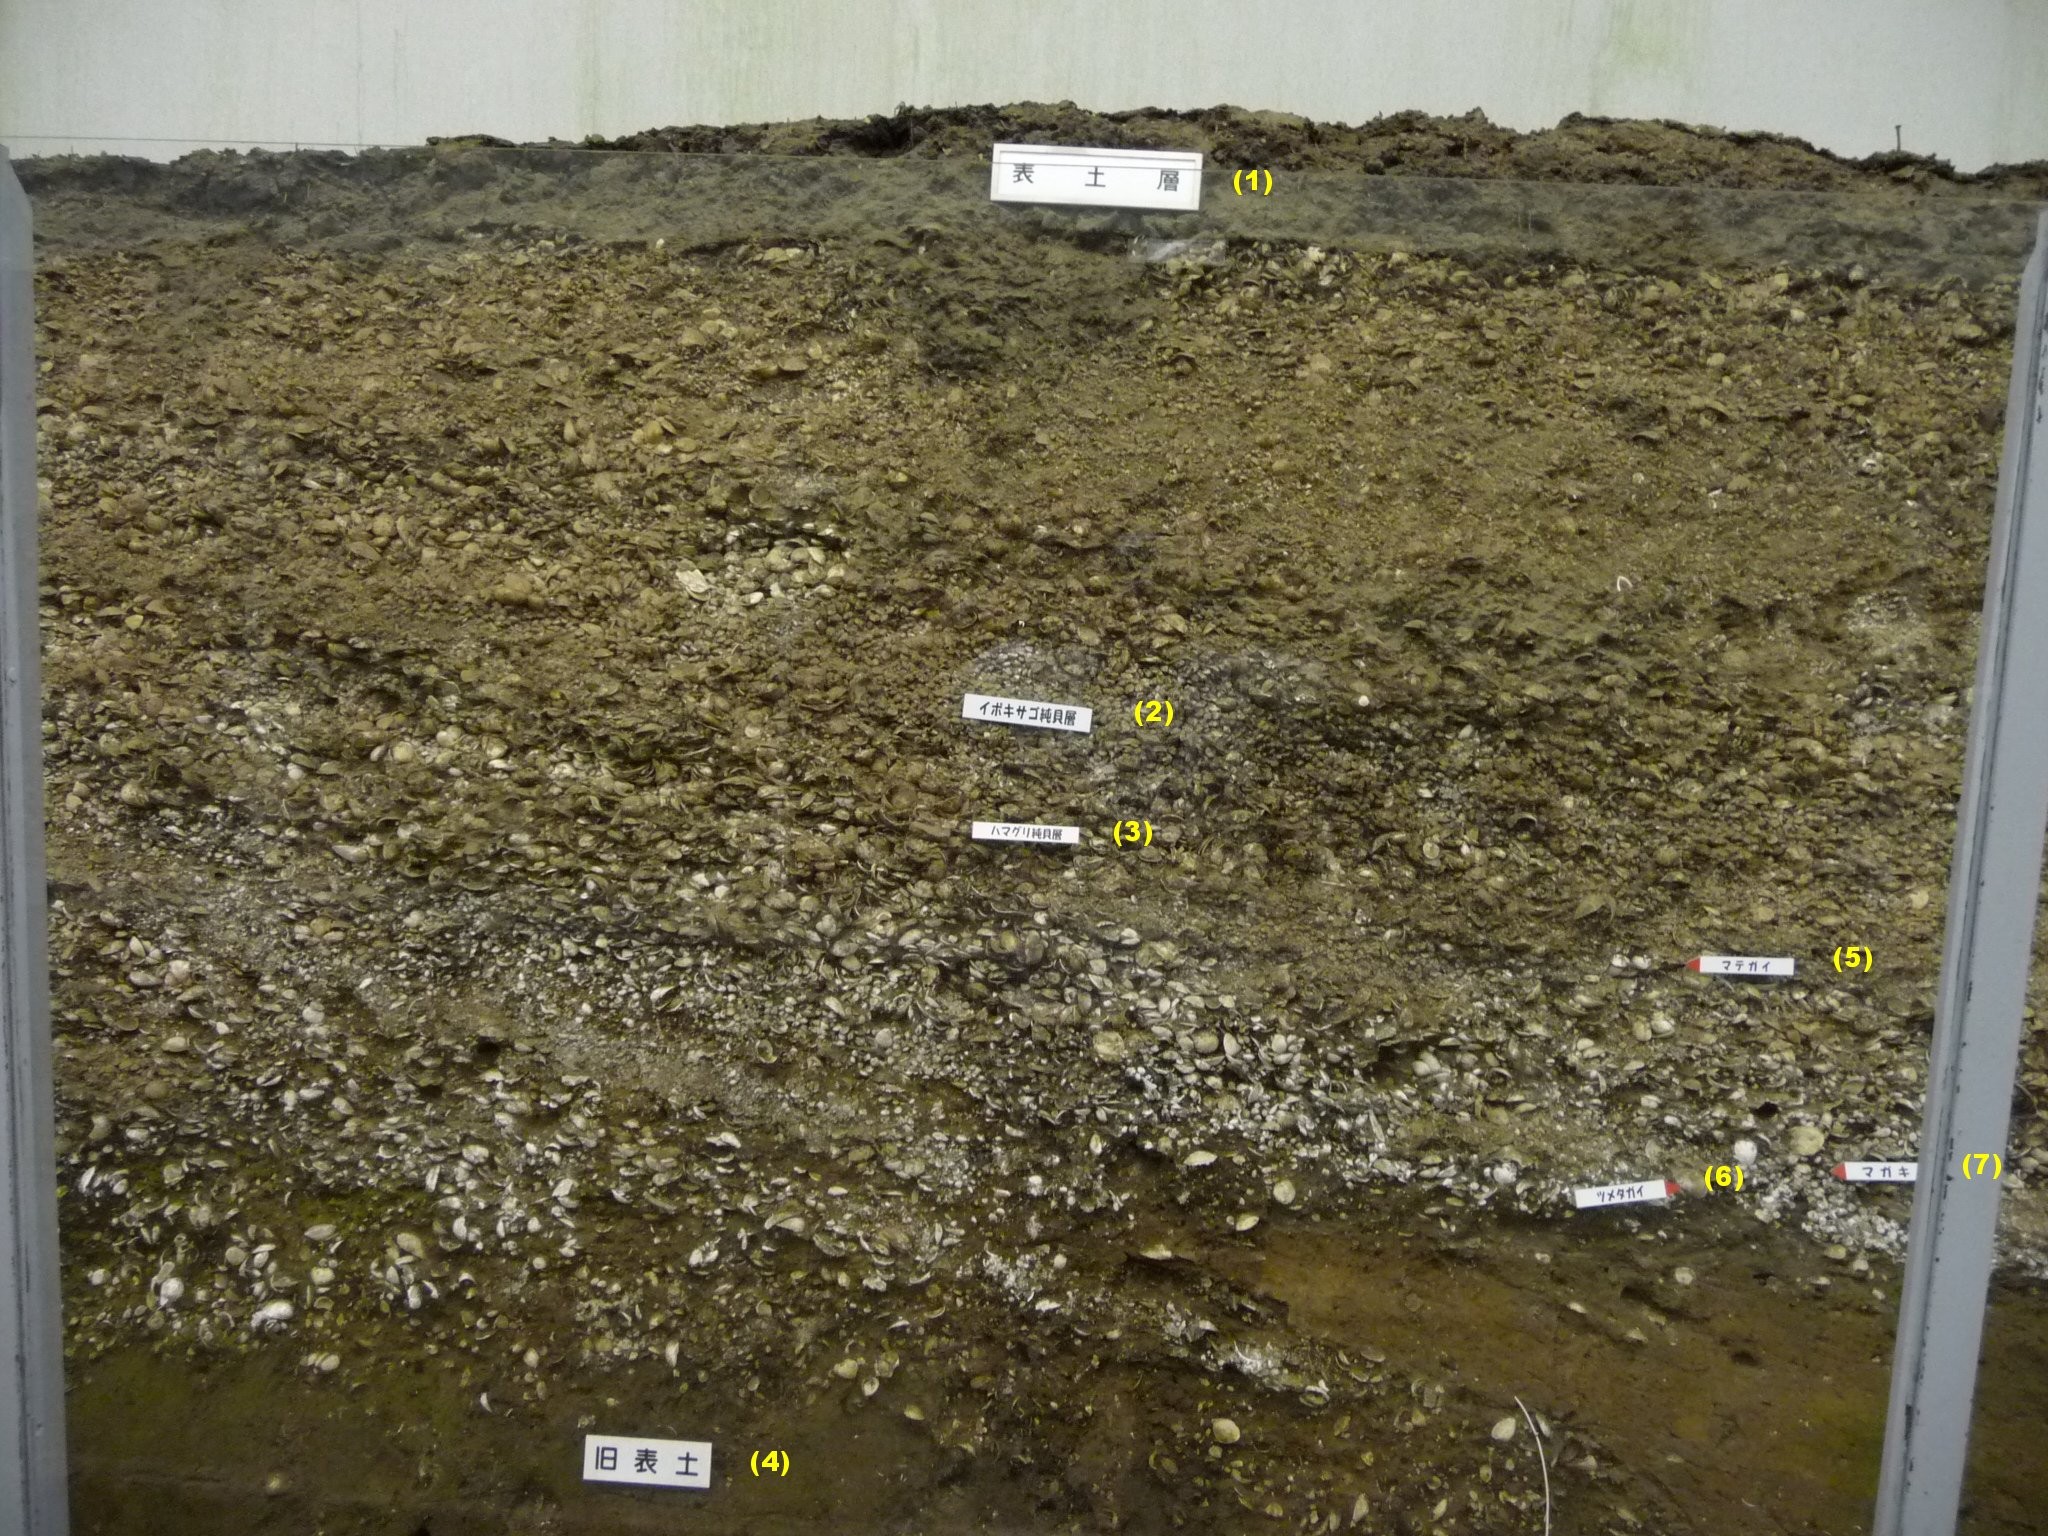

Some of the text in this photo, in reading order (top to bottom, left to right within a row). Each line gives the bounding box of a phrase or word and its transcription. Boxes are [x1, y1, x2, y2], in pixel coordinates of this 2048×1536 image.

[1012, 162, 1180, 193] 表土層
[979, 701, 1078, 727] イボキサゴ純貝層
[990, 825, 1064, 841] ハマグリ純貝層
[1721, 960, 1772, 973] マテガイ
[1861, 1166, 1911, 1179] マガキ
[1596, 1185, 1645, 1203] ツメタガイ
[595, 1445, 699, 1477] 旧表土
